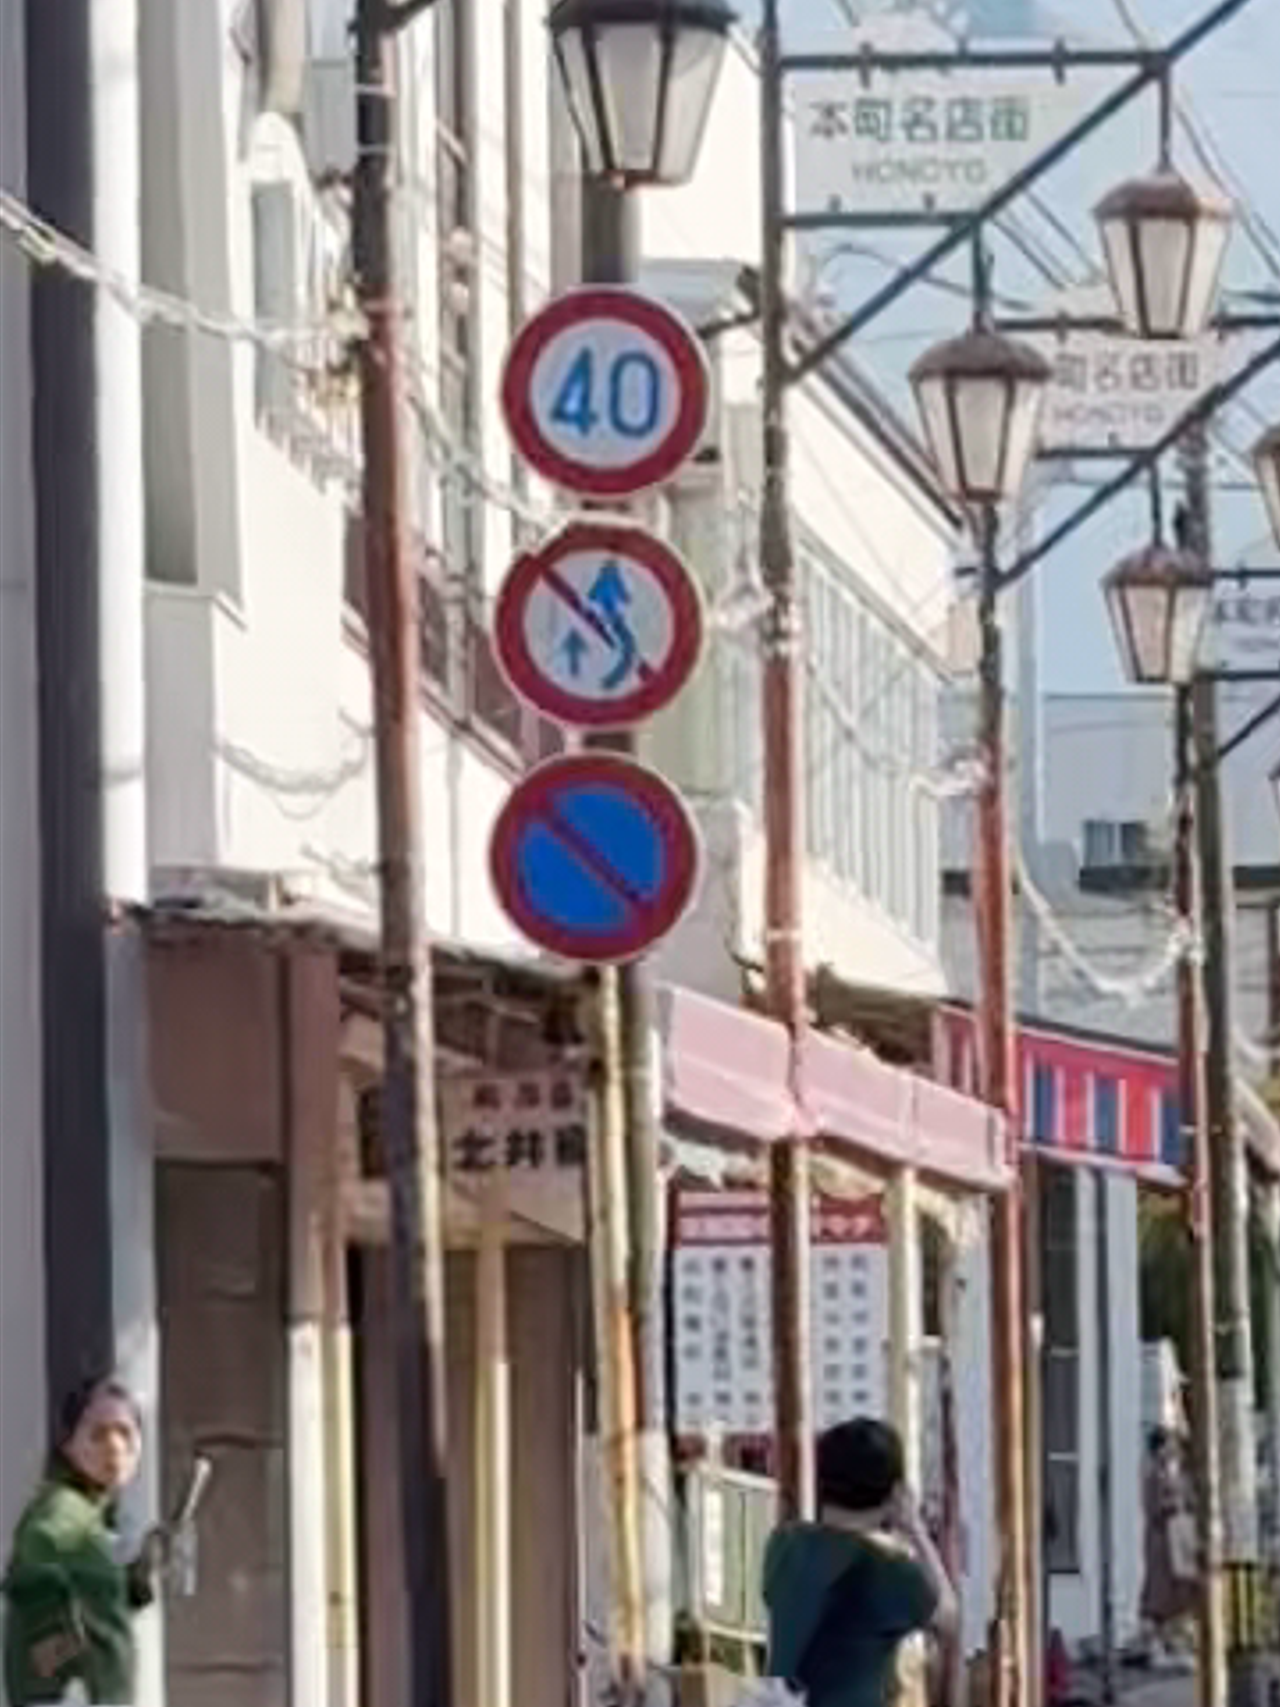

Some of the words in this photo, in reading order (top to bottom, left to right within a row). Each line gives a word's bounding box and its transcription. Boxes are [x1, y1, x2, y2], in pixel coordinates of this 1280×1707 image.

[808, 96, 1030, 145] 本町名店街
[550, 349, 658, 438] 40
